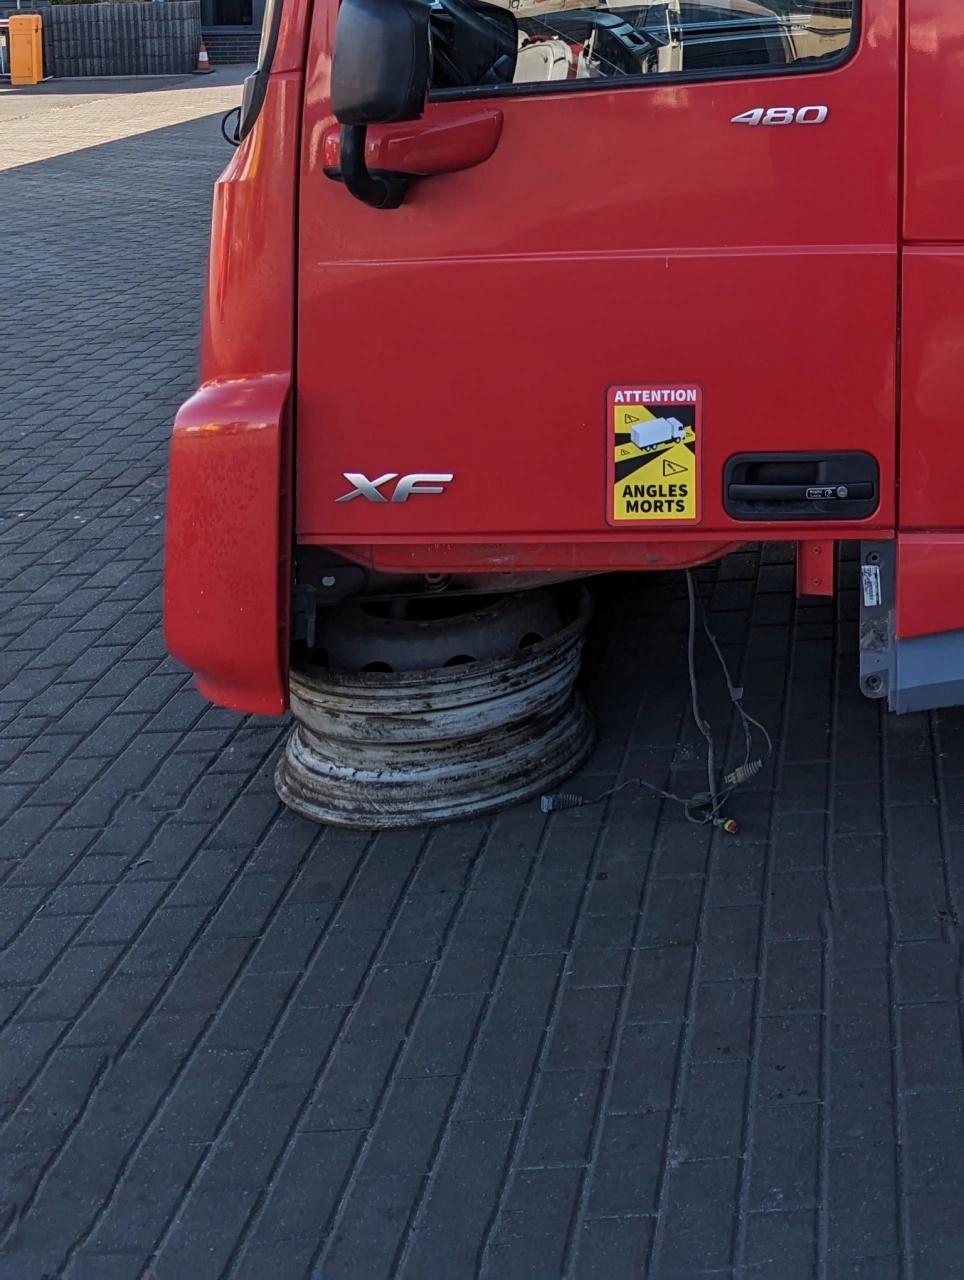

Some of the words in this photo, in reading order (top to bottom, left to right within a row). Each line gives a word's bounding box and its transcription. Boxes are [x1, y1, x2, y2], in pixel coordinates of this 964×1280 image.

[730, 105, 828, 126] 480
[614, 389, 697, 402] ATTENTION
[334, 472, 454, 502] XF
[622, 484, 688, 498] ANGLES
[626, 500, 685, 513] MORTS
